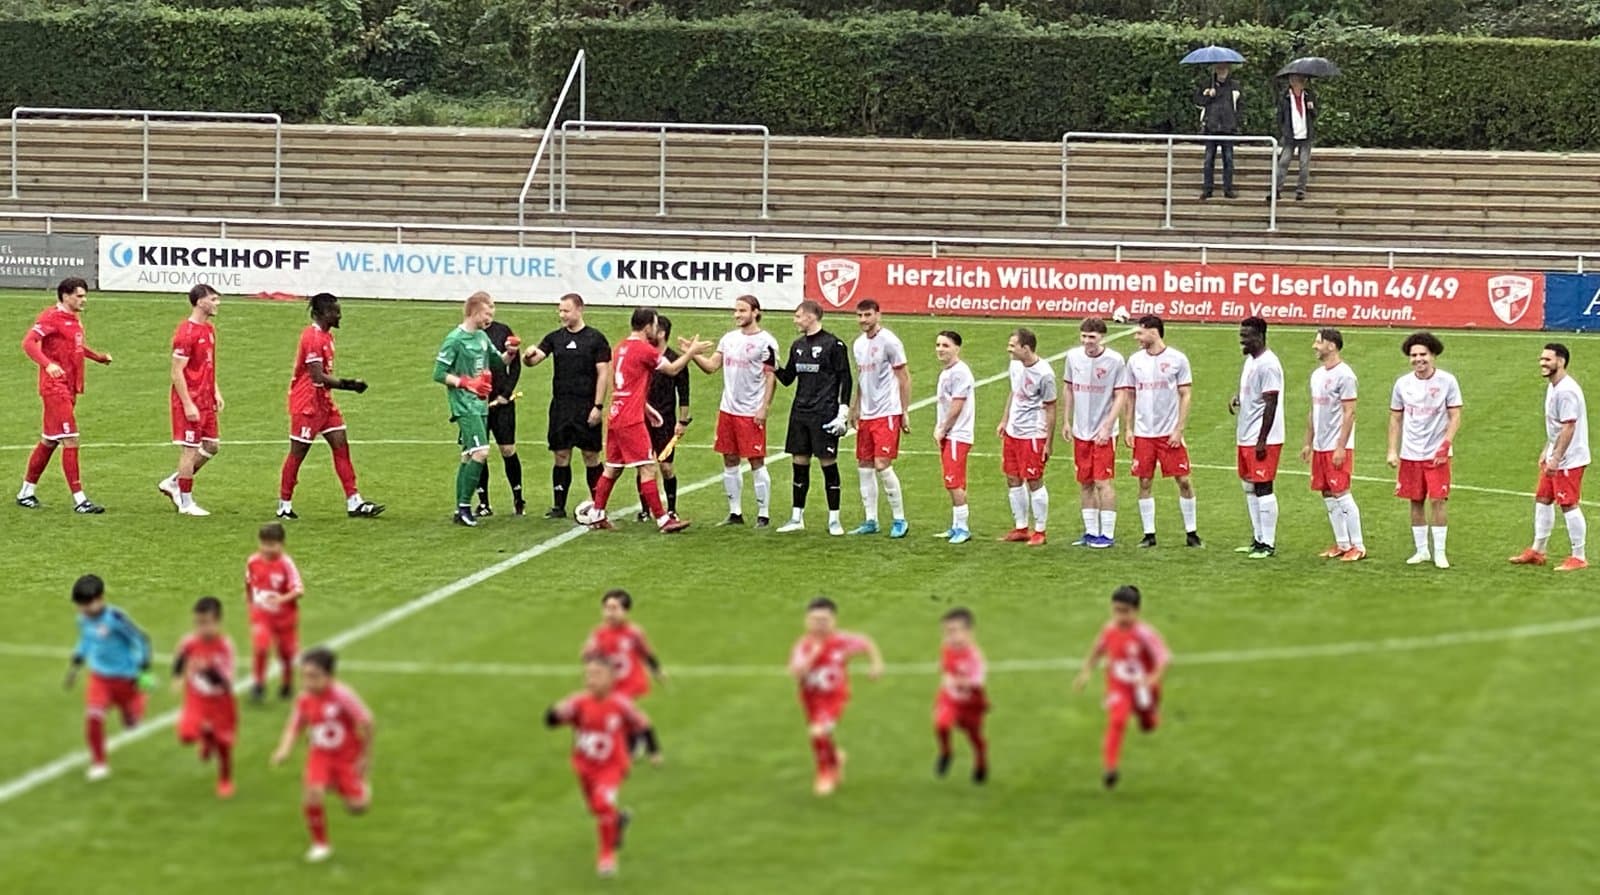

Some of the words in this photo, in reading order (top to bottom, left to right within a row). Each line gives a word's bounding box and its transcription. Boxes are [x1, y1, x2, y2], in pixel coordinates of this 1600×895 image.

[138, 246, 310, 270] KIRCHHOFF
[336, 251, 563, 278] WE.MOVE.FUTURE.
[0, 266, 56, 277] SEILERSEE
[137, 271, 241, 287] AUTOMOTIVE
[616, 259, 793, 283] KIRCHHOFF
[887, 264, 990, 288] Herzlich
[997, 266, 1157, 292] Willkommen
[1163, 270, 1225, 294] beim
[1233, 273, 1265, 295] FC
[1272, 274, 1379, 298] Iserlohn
[1384, 274, 1460, 300] 46/49
[616, 285, 723, 300] AUTOMOTIVE
[928, 294, 1032, 311] Leidenschaft
[1131, 299, 1165, 314] Eine
[1169, 299, 1216, 315] Stadt.
[1221, 301, 1244, 316] Ein
[1250, 302, 1307, 318] Verein.
[1312, 304, 1347, 319] Eine
[1352, 304, 1417, 321] Zukunft.
